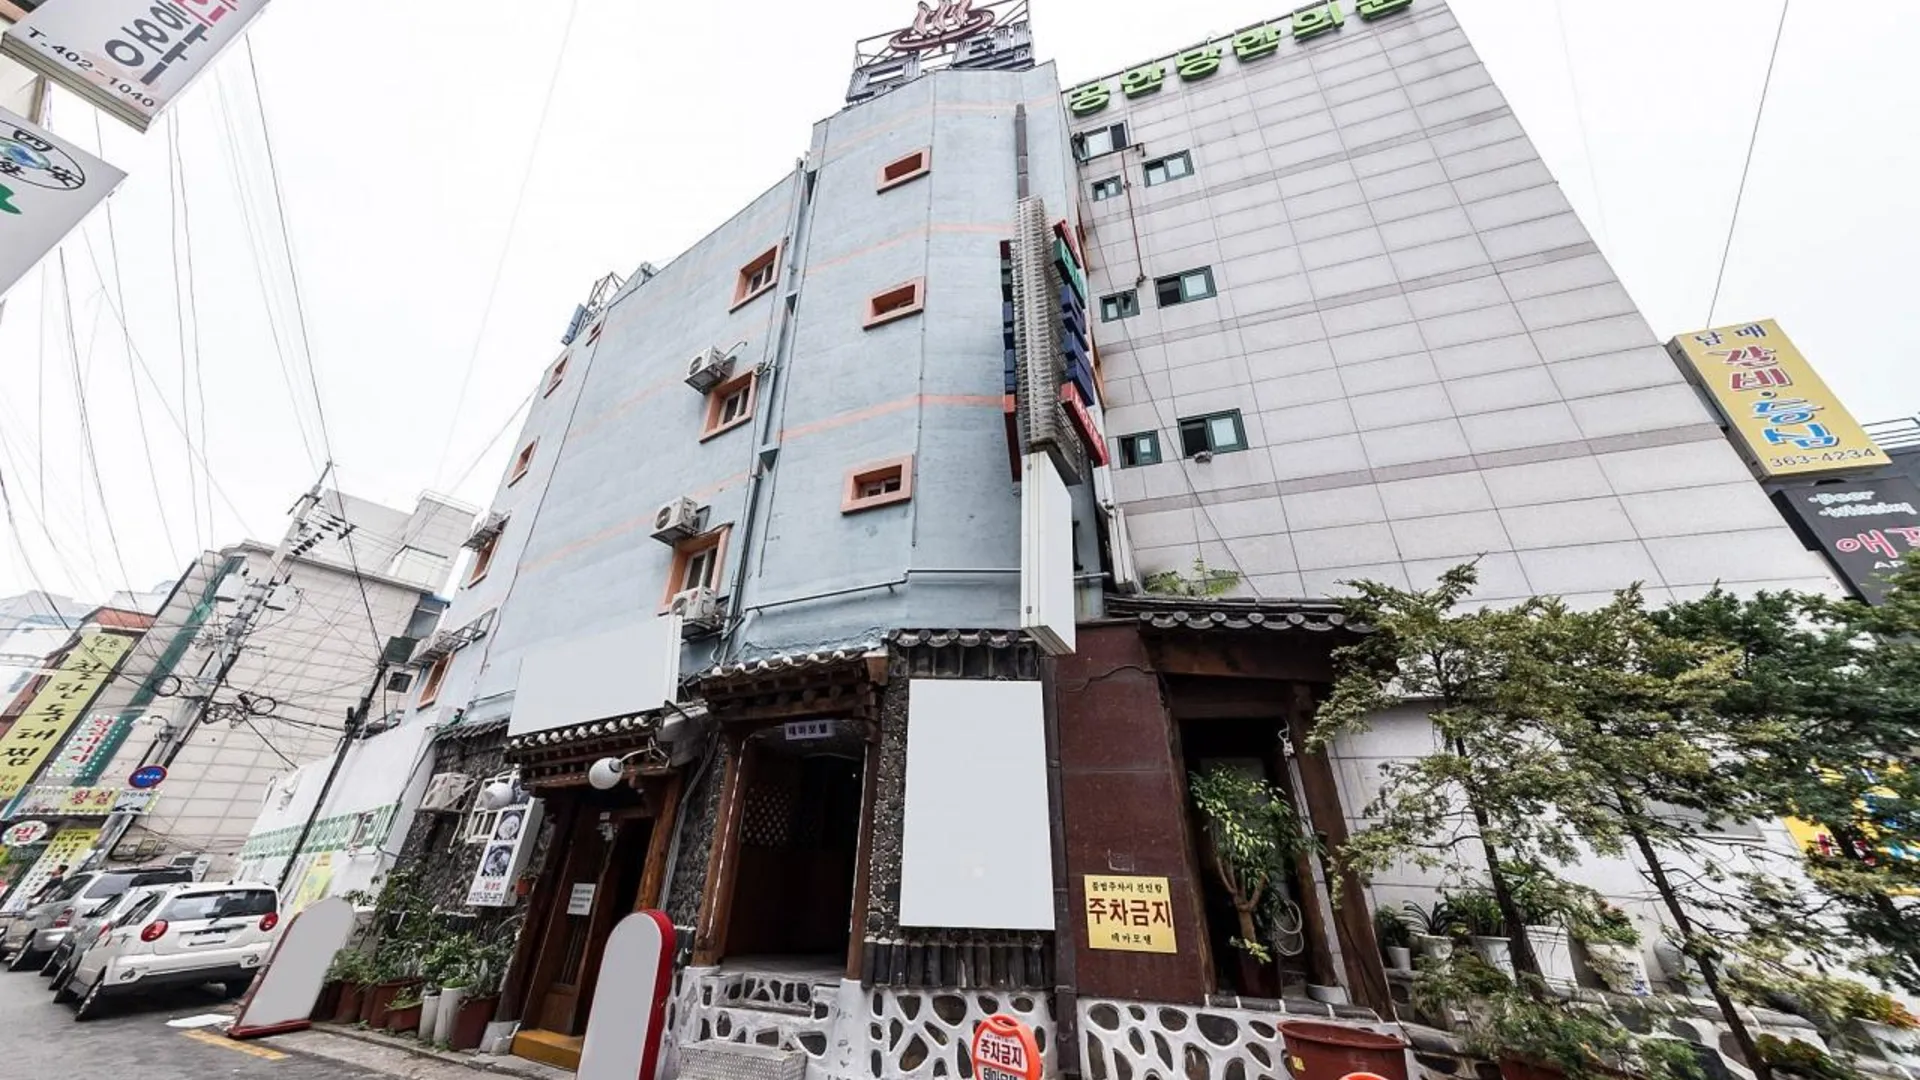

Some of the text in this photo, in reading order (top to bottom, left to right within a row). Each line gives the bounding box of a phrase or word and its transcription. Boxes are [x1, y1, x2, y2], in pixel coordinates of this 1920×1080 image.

[1769, 448, 1876, 468] 363-4234
[1088, 898, 1172, 928] 주차금지
[981, 1038, 1023, 1069] 주차금지
